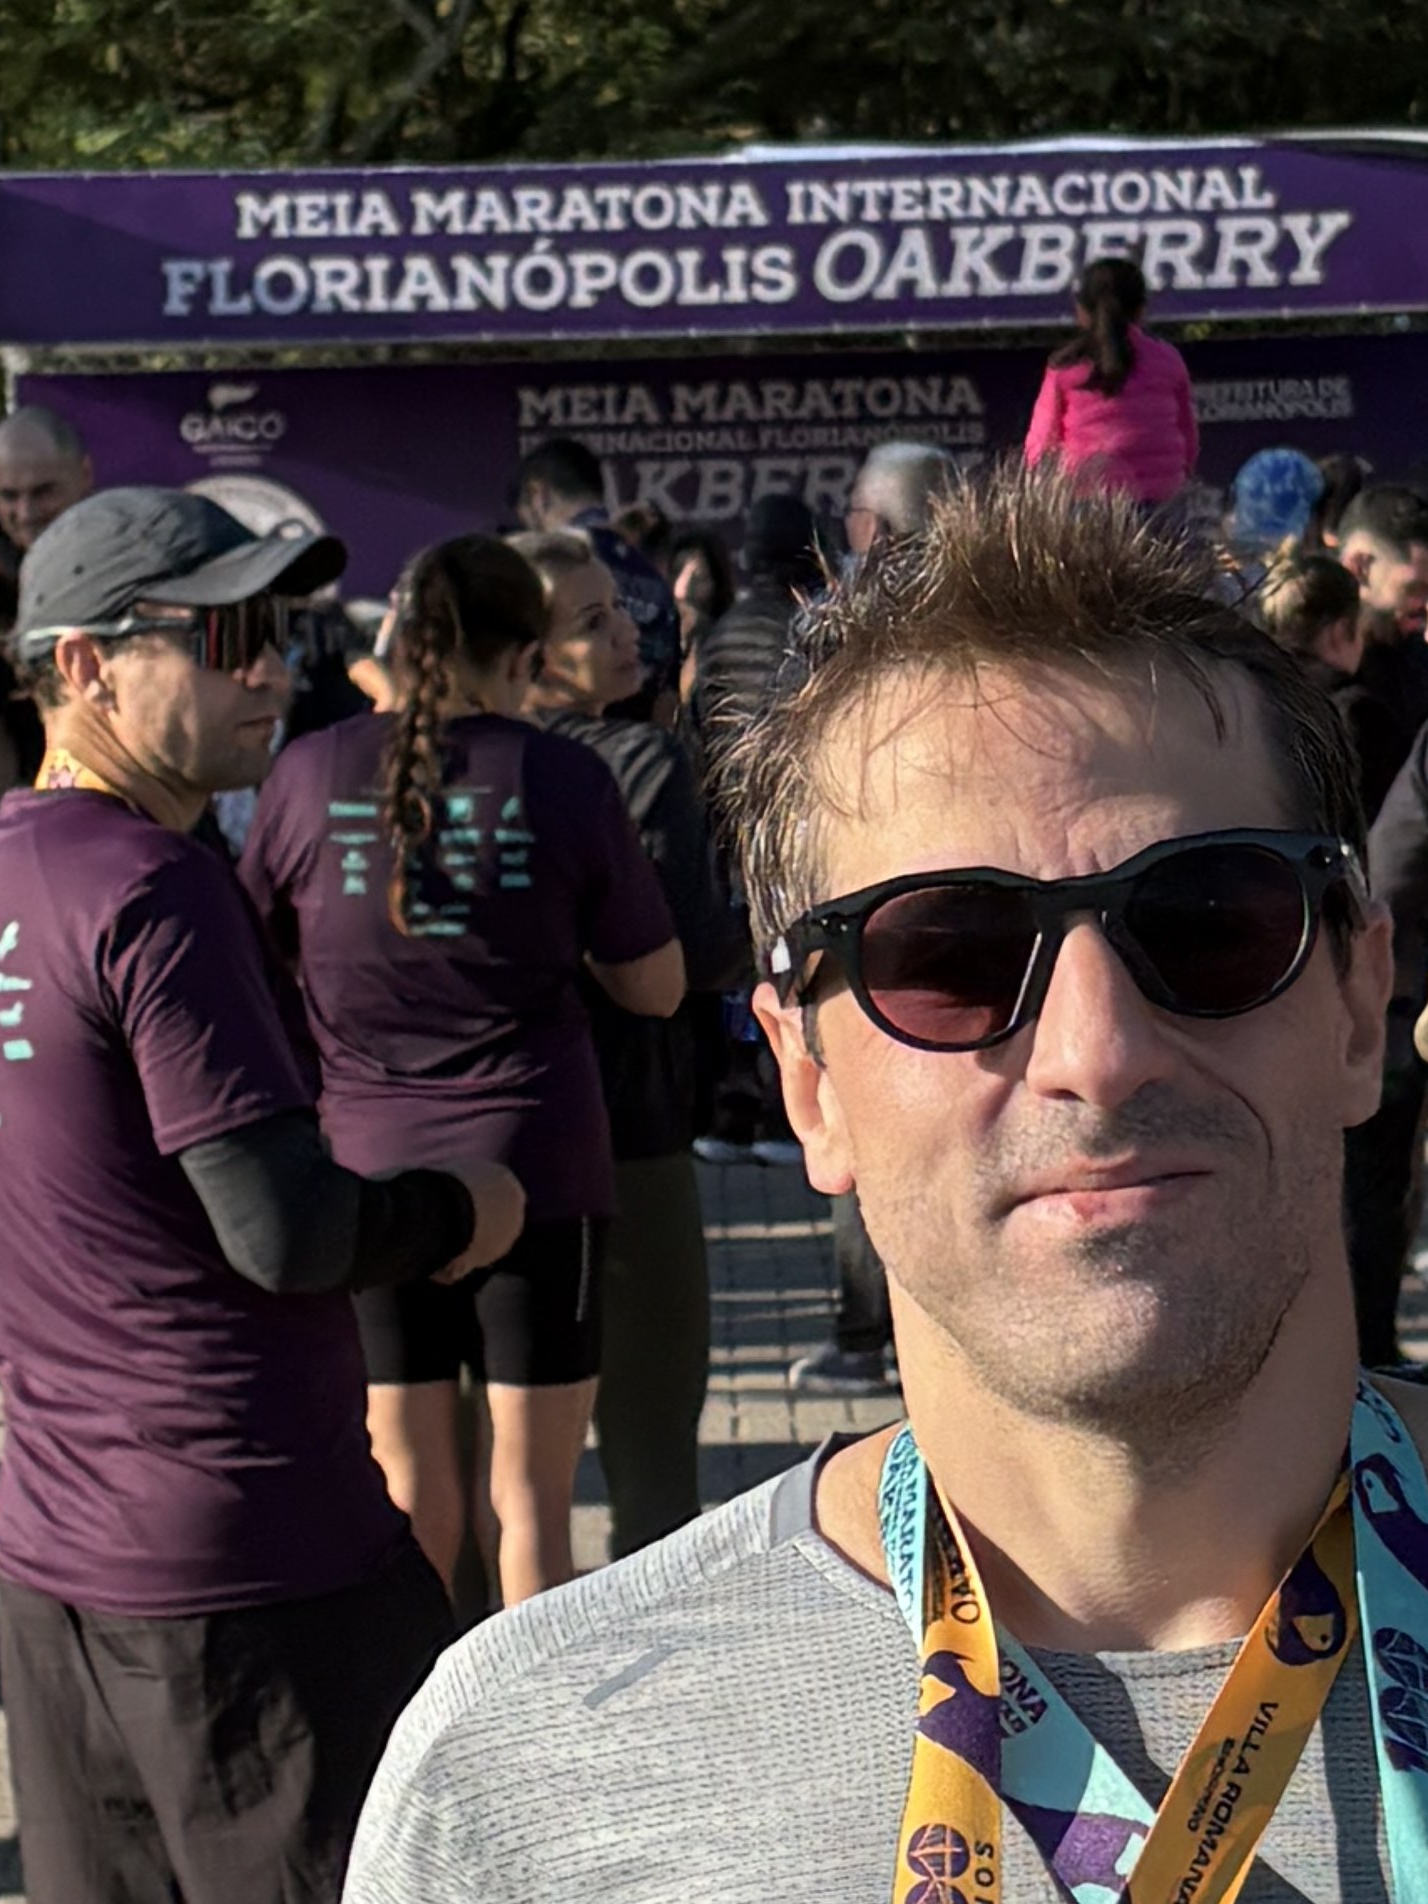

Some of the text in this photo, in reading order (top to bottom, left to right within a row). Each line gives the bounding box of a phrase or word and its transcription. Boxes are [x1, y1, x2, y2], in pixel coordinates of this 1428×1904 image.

[236, 166, 1275, 239] MEIA MARATONA INTERNACIONAL
[161, 211, 1350, 316] FLORIANÓPOLIS OAKBERRY
[178, 411, 286, 443] GAICO
[517, 375, 984, 427] MEIA MARATONA
[1233, 1701, 1280, 1775] VILLA
